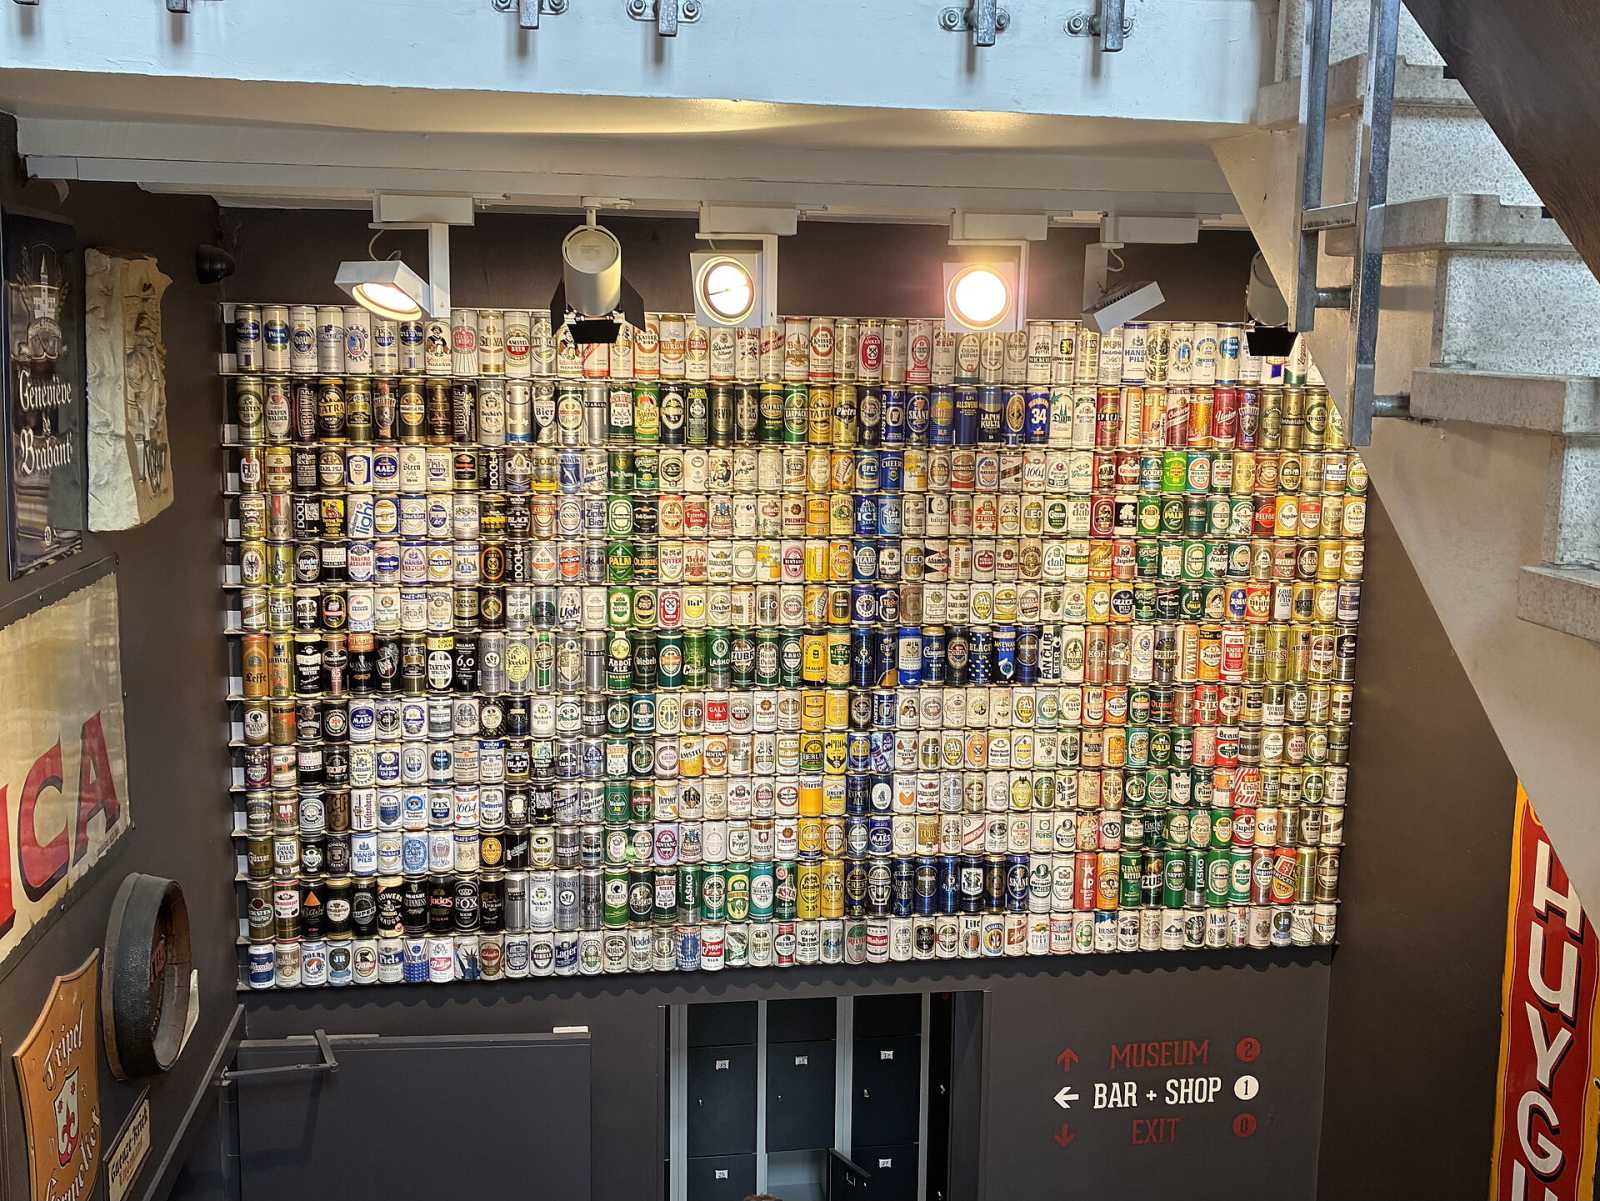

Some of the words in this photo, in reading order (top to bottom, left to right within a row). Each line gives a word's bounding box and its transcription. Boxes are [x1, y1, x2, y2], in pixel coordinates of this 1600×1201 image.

[1031, 408, 1048, 422] 34
[376, 464, 397, 473] MAES
[608, 556, 632, 566] PALM
[245, 670, 268, 686] Leffe
[352, 716, 373, 724] MAES
[872, 834, 891, 843] MAES
[1143, 877, 1161, 889] ZUB
[428, 894, 454, 907] Judas
[1109, 1039, 1211, 1072] MUSEUM
[1093, 1081, 1138, 1109] BAR
[1165, 1076, 1222, 1105] SHOP
[1130, 1117, 1182, 1145] EXIT
